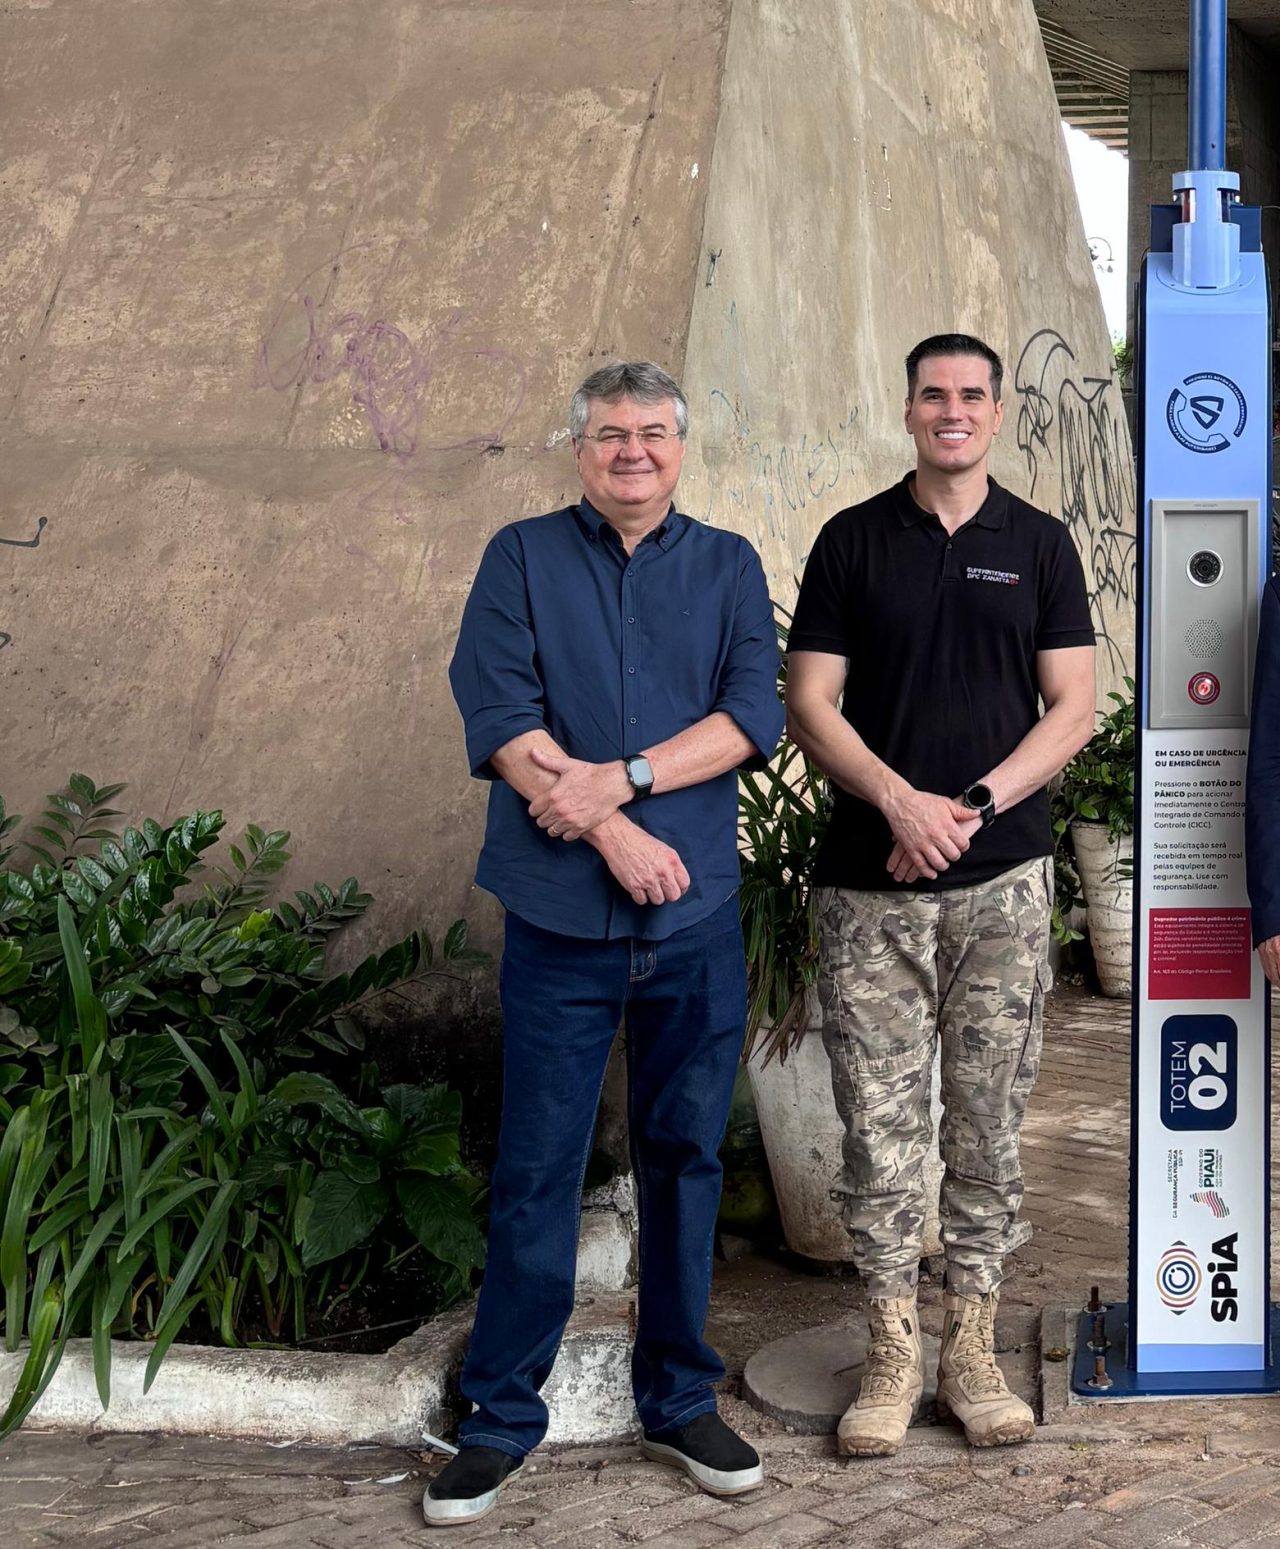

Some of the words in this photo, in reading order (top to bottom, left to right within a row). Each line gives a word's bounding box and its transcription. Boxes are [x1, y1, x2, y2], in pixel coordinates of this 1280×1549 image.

[1169, 759, 1221, 767] EMERGÊNCIA
[1200, 779, 1227, 787] BOTÃO
[1170, 842, 1210, 850] solicitação
[1171, 1041, 1186, 1113] TOTEM
[1188, 1042, 1228, 1110] 02
[1199, 1149, 1203, 1157] DO
[1207, 1232, 1238, 1322] SPiA
